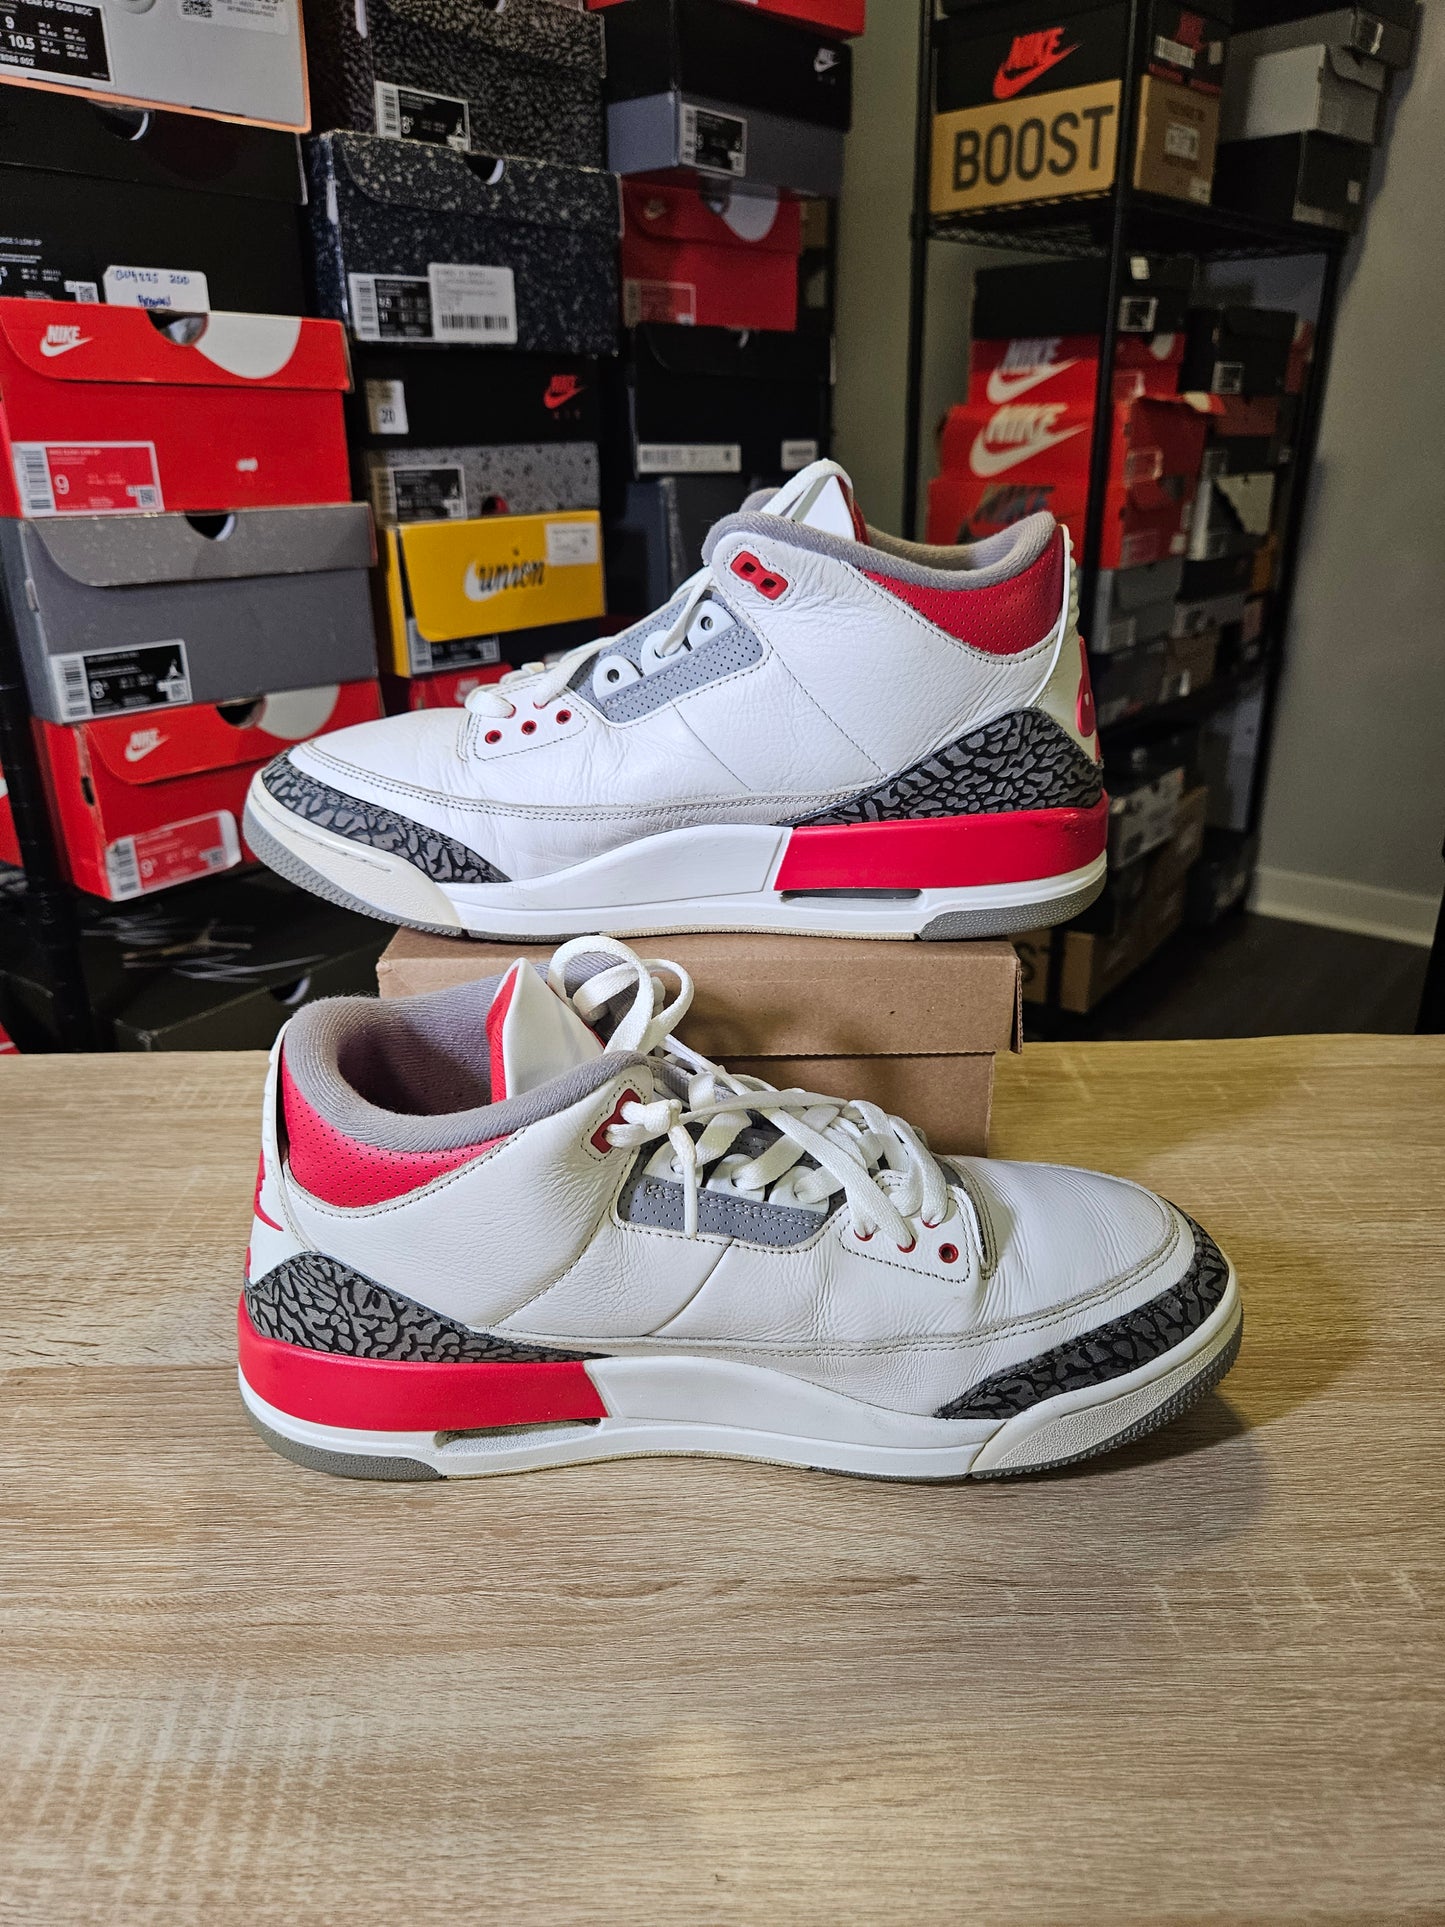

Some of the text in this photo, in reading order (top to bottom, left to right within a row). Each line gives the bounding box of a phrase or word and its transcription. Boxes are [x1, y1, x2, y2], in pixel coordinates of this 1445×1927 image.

[5, 16, 15, 29] 9
[8, 34, 36, 50] 10.5
[952, 104, 1114, 193] BOOST
[47, 324, 81, 343] NIKE
[984, 402, 1068, 443] NIKE
[54, 474, 70, 495] 9
[478, 547, 546, 594] union
[130, 727, 160, 749] NIKE
